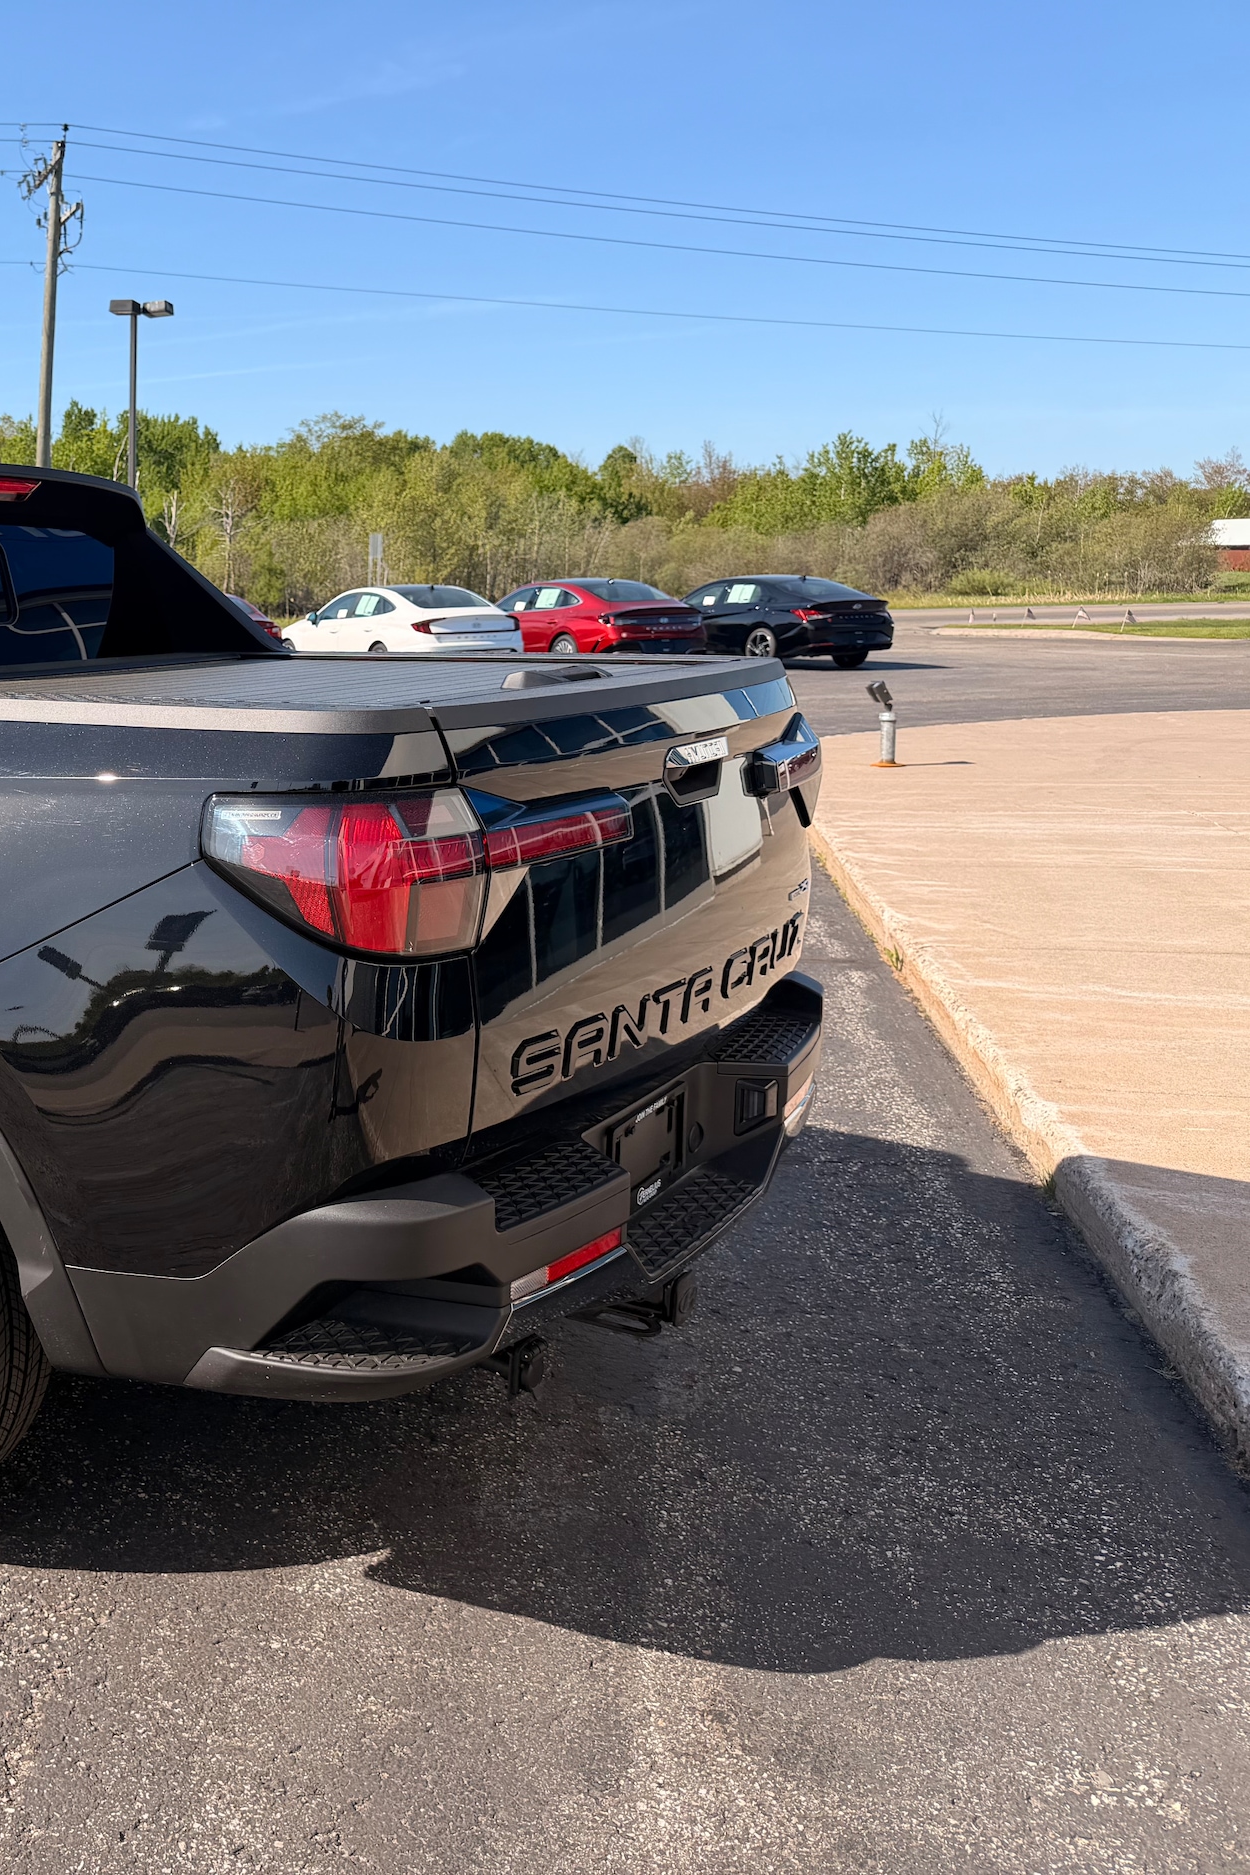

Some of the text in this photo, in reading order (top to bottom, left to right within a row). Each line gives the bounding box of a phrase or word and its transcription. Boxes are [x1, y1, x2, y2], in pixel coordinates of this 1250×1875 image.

[510, 966, 713, 1096] SANTA
[635, 1110, 646, 1123] JOIN
[653, 1095, 668, 1111] FAMILY
